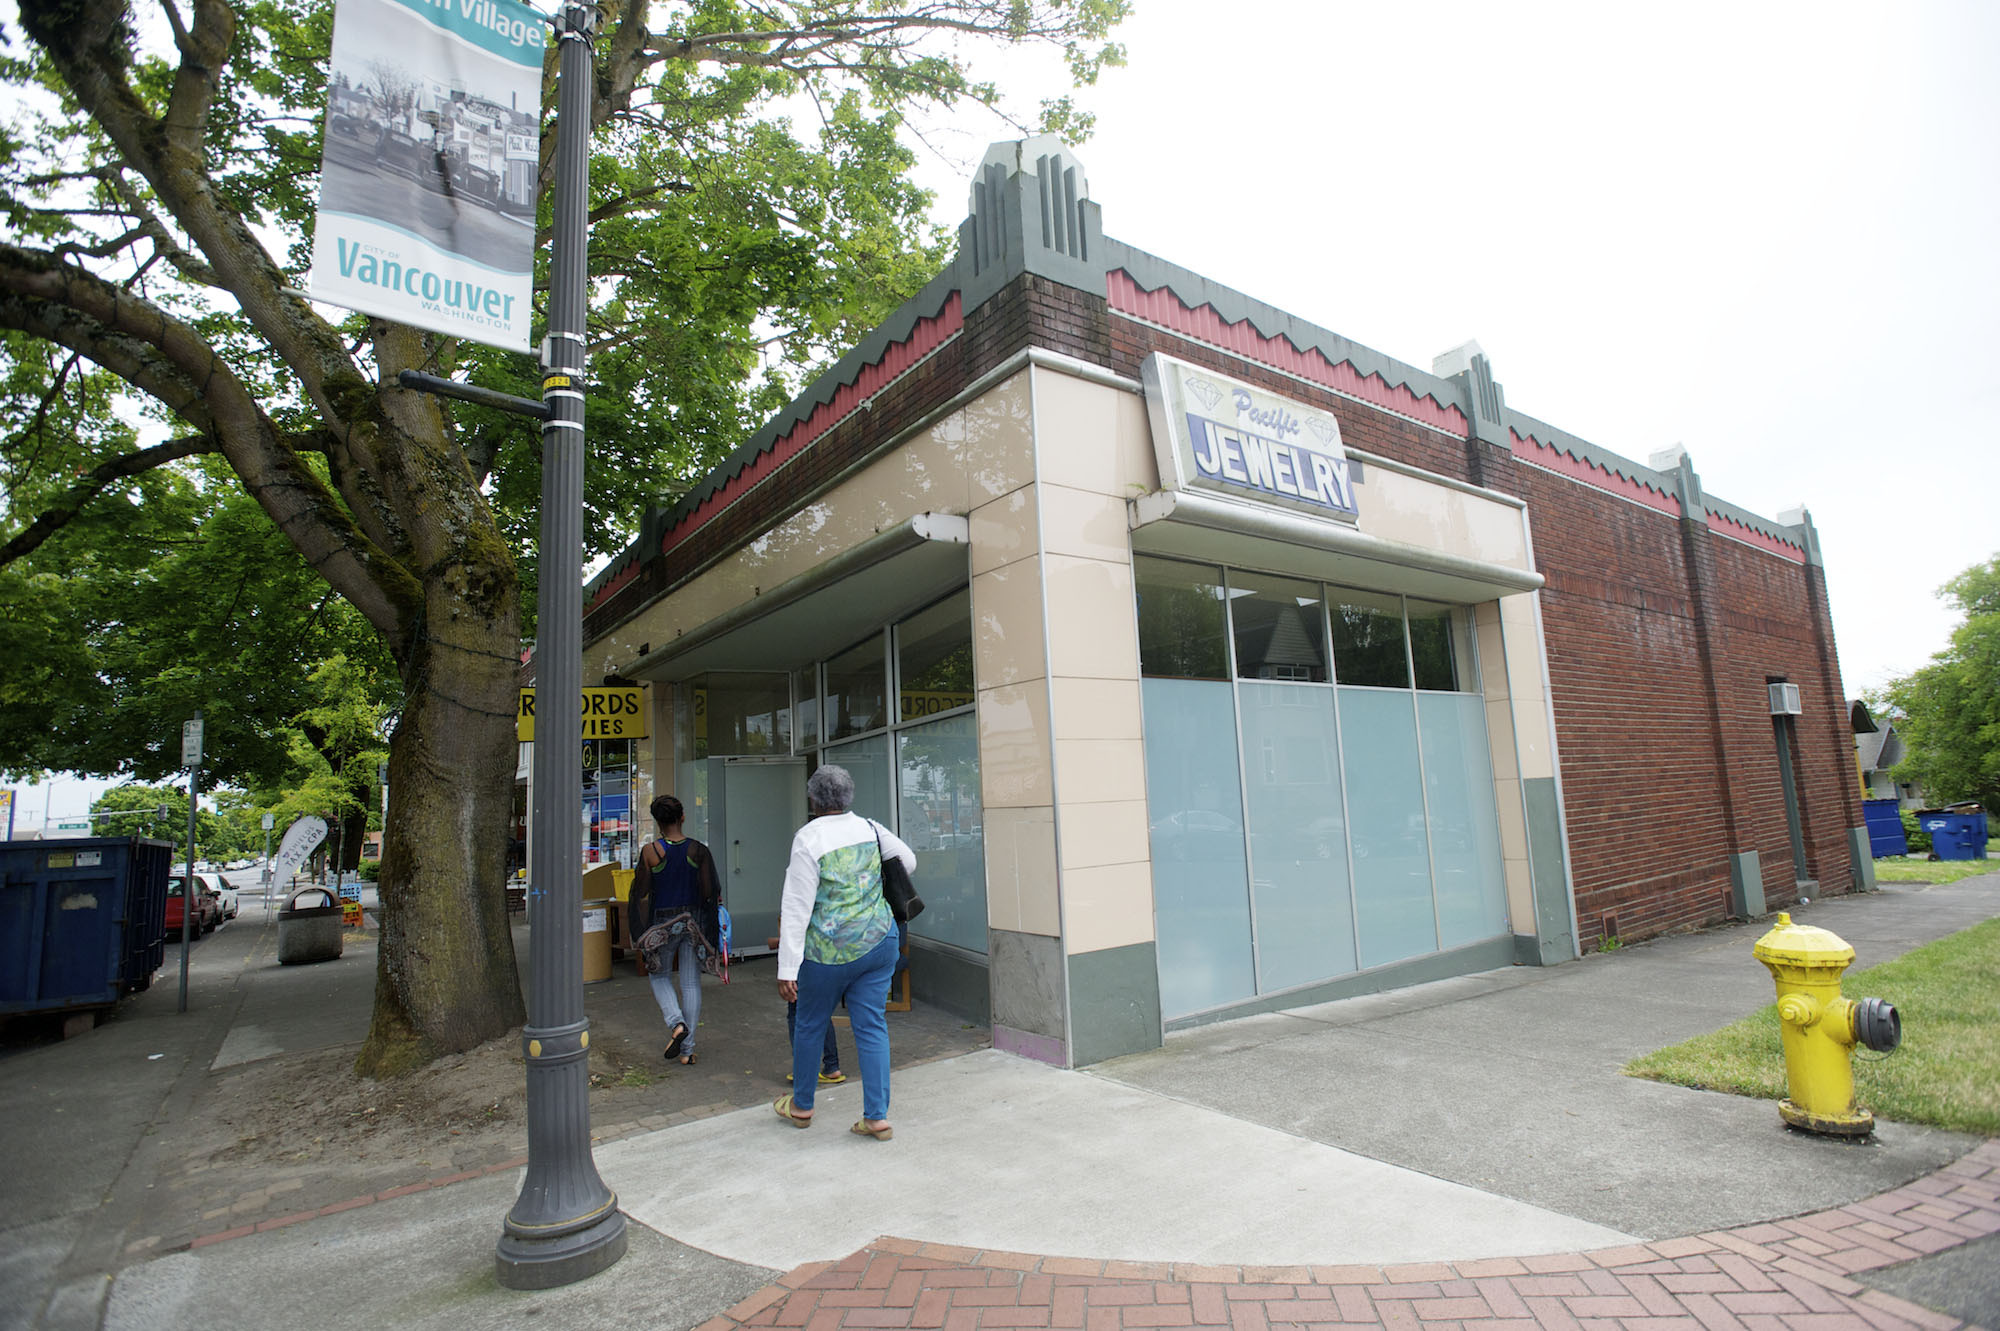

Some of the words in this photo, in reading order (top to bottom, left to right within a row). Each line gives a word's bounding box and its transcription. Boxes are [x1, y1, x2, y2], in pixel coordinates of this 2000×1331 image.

[460, 0, 541, 47] Village
[364, 245, 384, 255] CITY
[337, 237, 515, 320] Vancouver
[421, 301, 511, 331] WASHINGTON
[1232, 388, 1300, 438] Pacific
[1195, 421, 1351, 509] JEWELRY
[522, 693, 639, 716] RRDS
[285, 851, 302, 867] TAX
[308, 829, 323, 843] CPA
